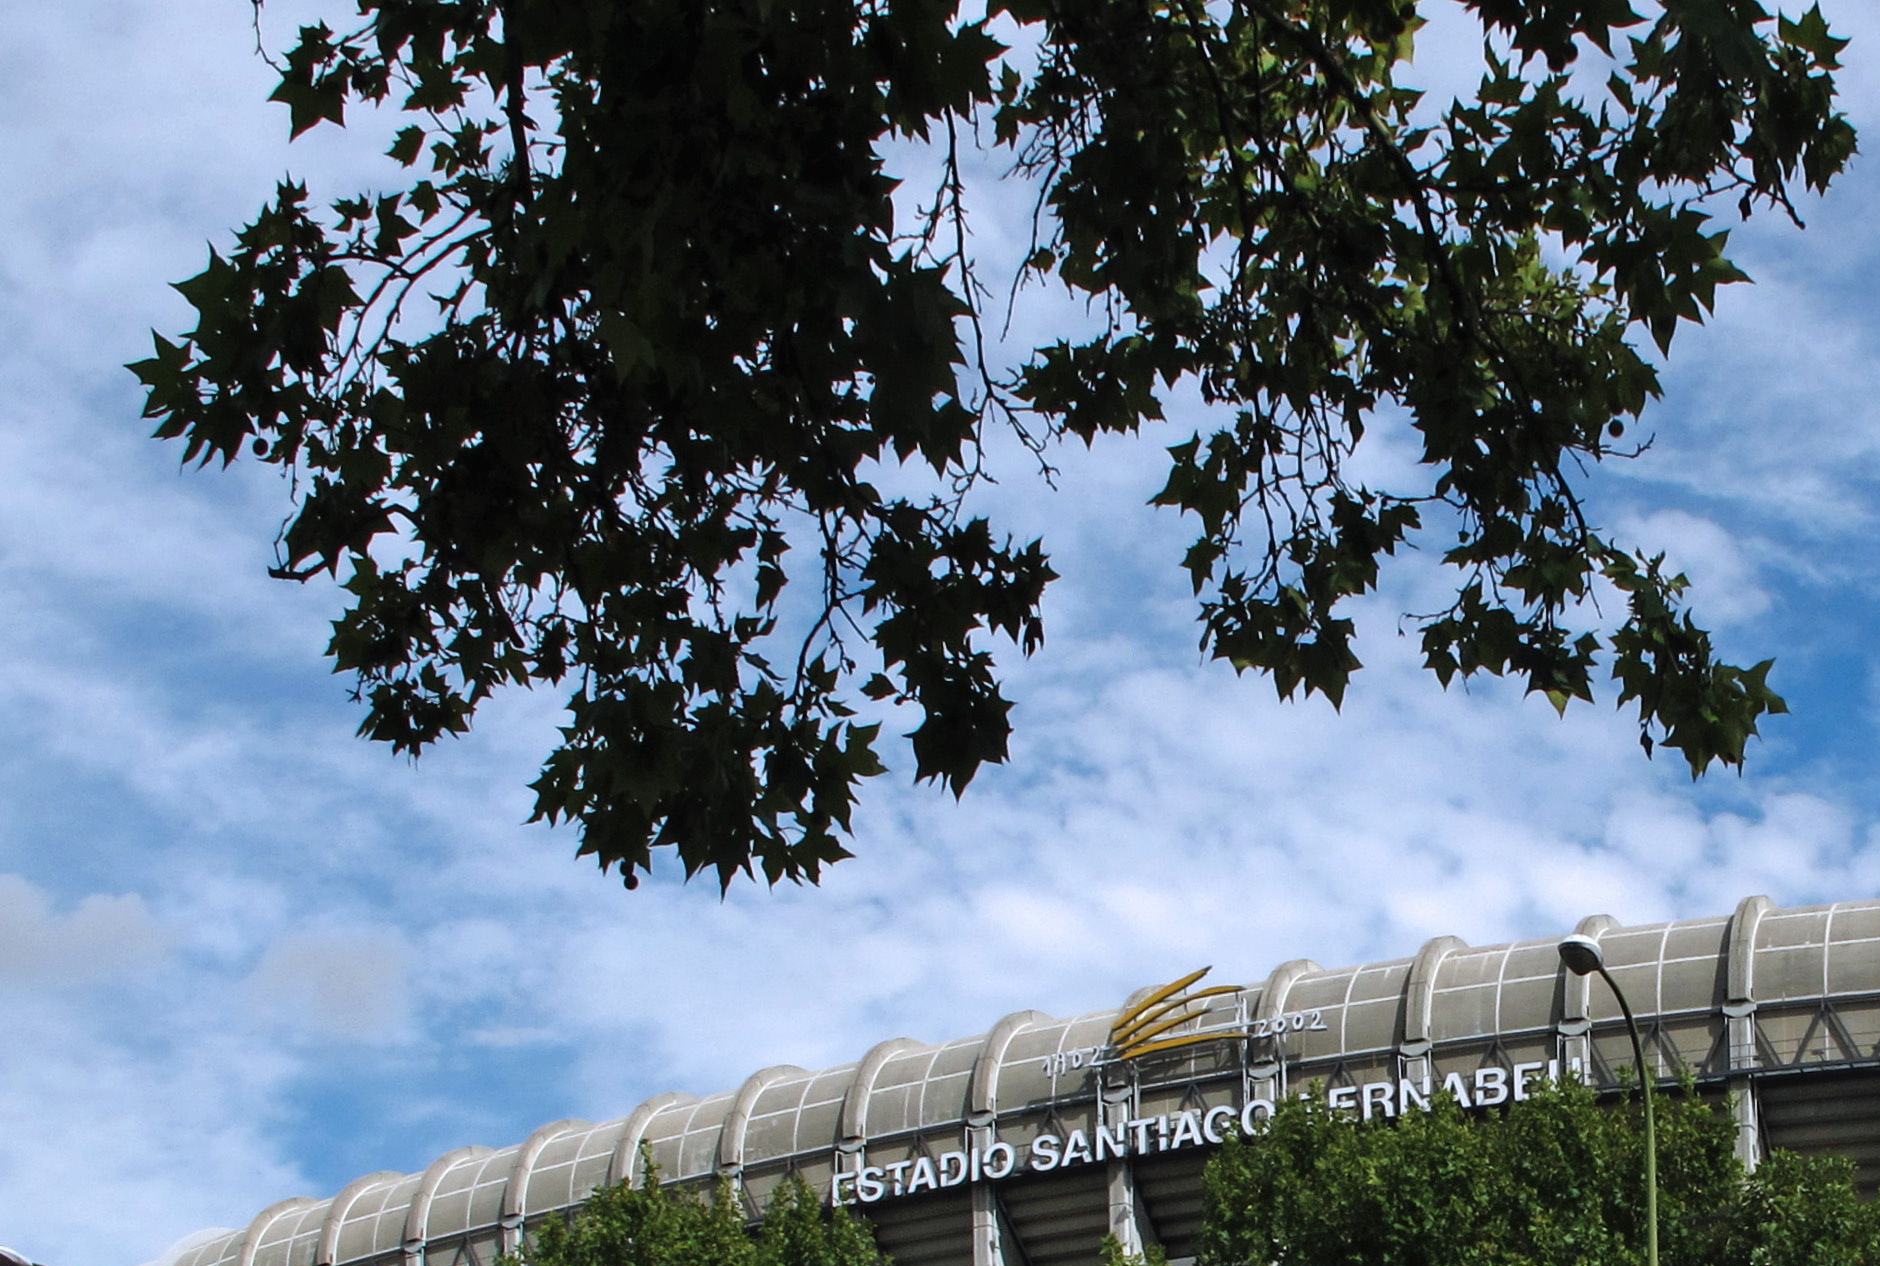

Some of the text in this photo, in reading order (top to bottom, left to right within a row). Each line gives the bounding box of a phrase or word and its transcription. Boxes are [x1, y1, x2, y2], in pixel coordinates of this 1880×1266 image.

[1252, 1010, 1328, 1039] 2002
[831, 1057, 1581, 1208] ESTADIO SANTIAGO ERNABE
